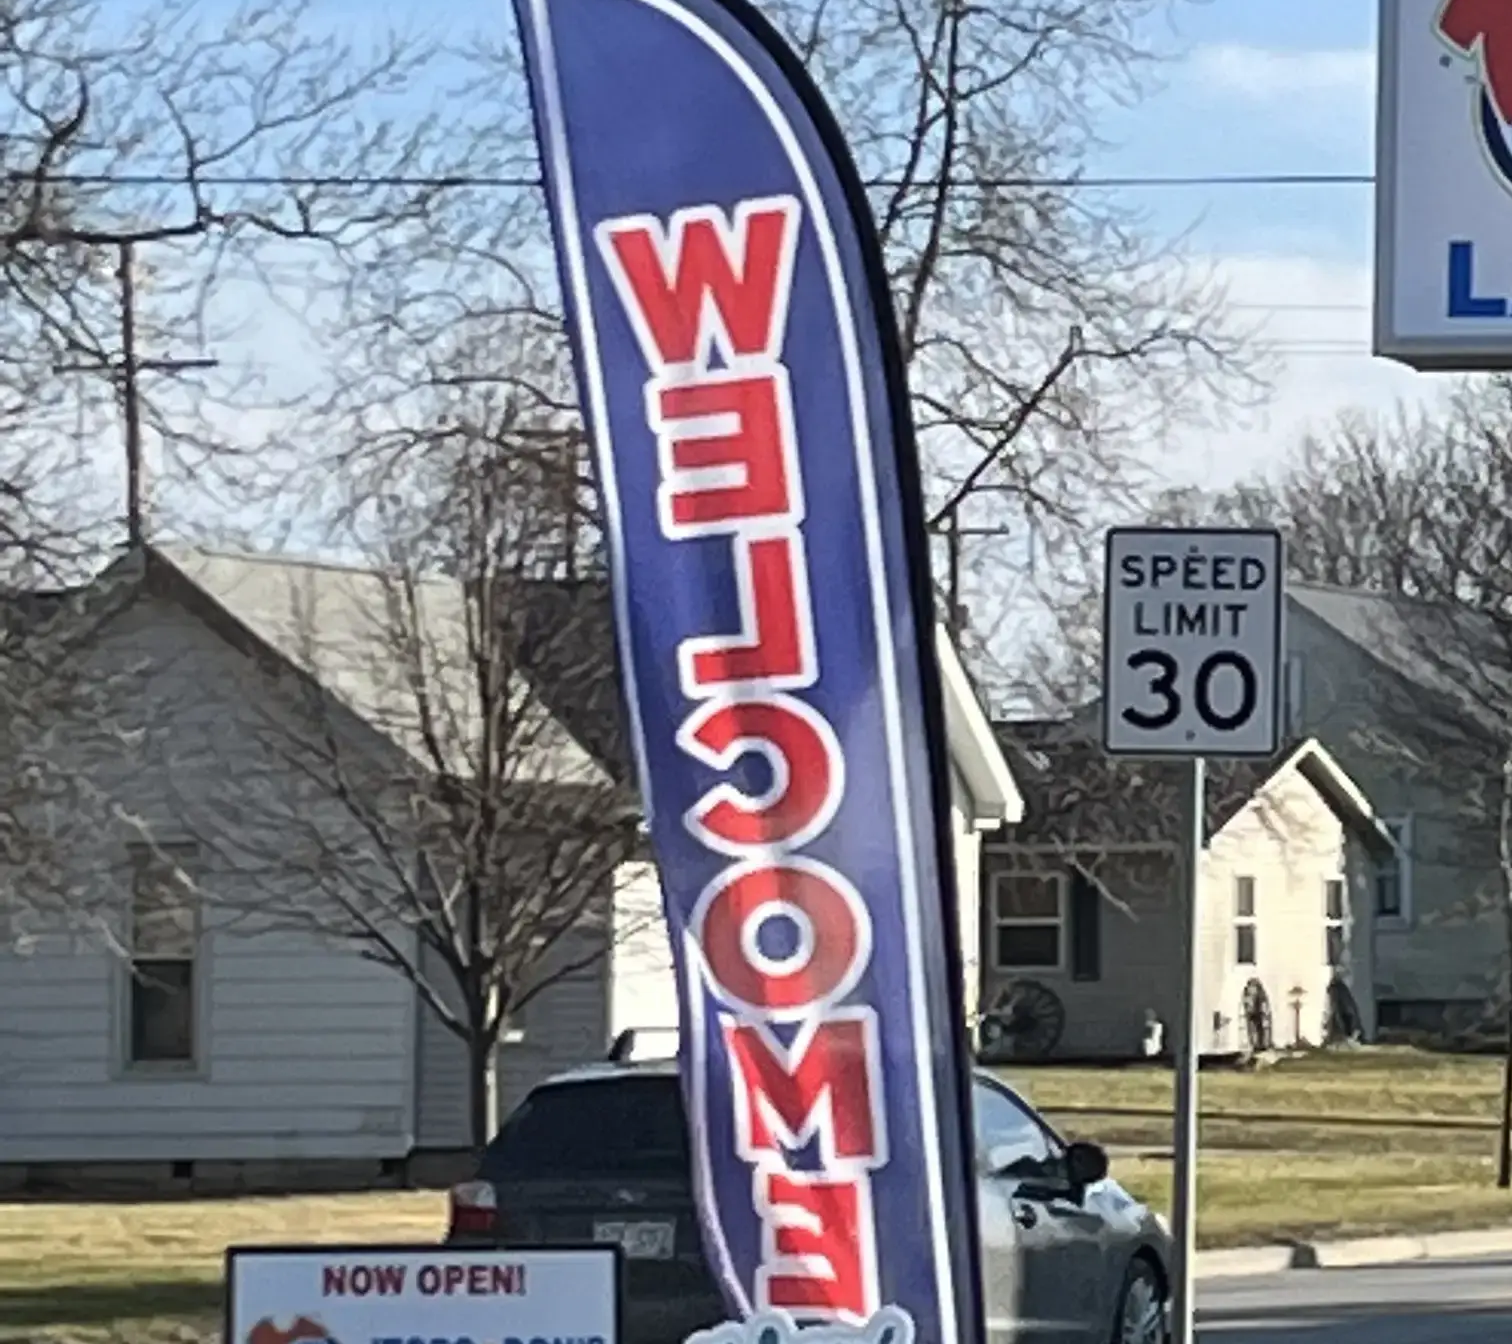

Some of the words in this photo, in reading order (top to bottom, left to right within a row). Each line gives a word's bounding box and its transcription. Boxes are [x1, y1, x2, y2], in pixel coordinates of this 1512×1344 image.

[1121, 554, 1267, 590] SPEED
[1134, 602, 1249, 637] LIMIT
[1121, 649, 1258, 731] 30
[321, 1264, 408, 1298] NOW
[417, 1263, 527, 1296] OPEN!
